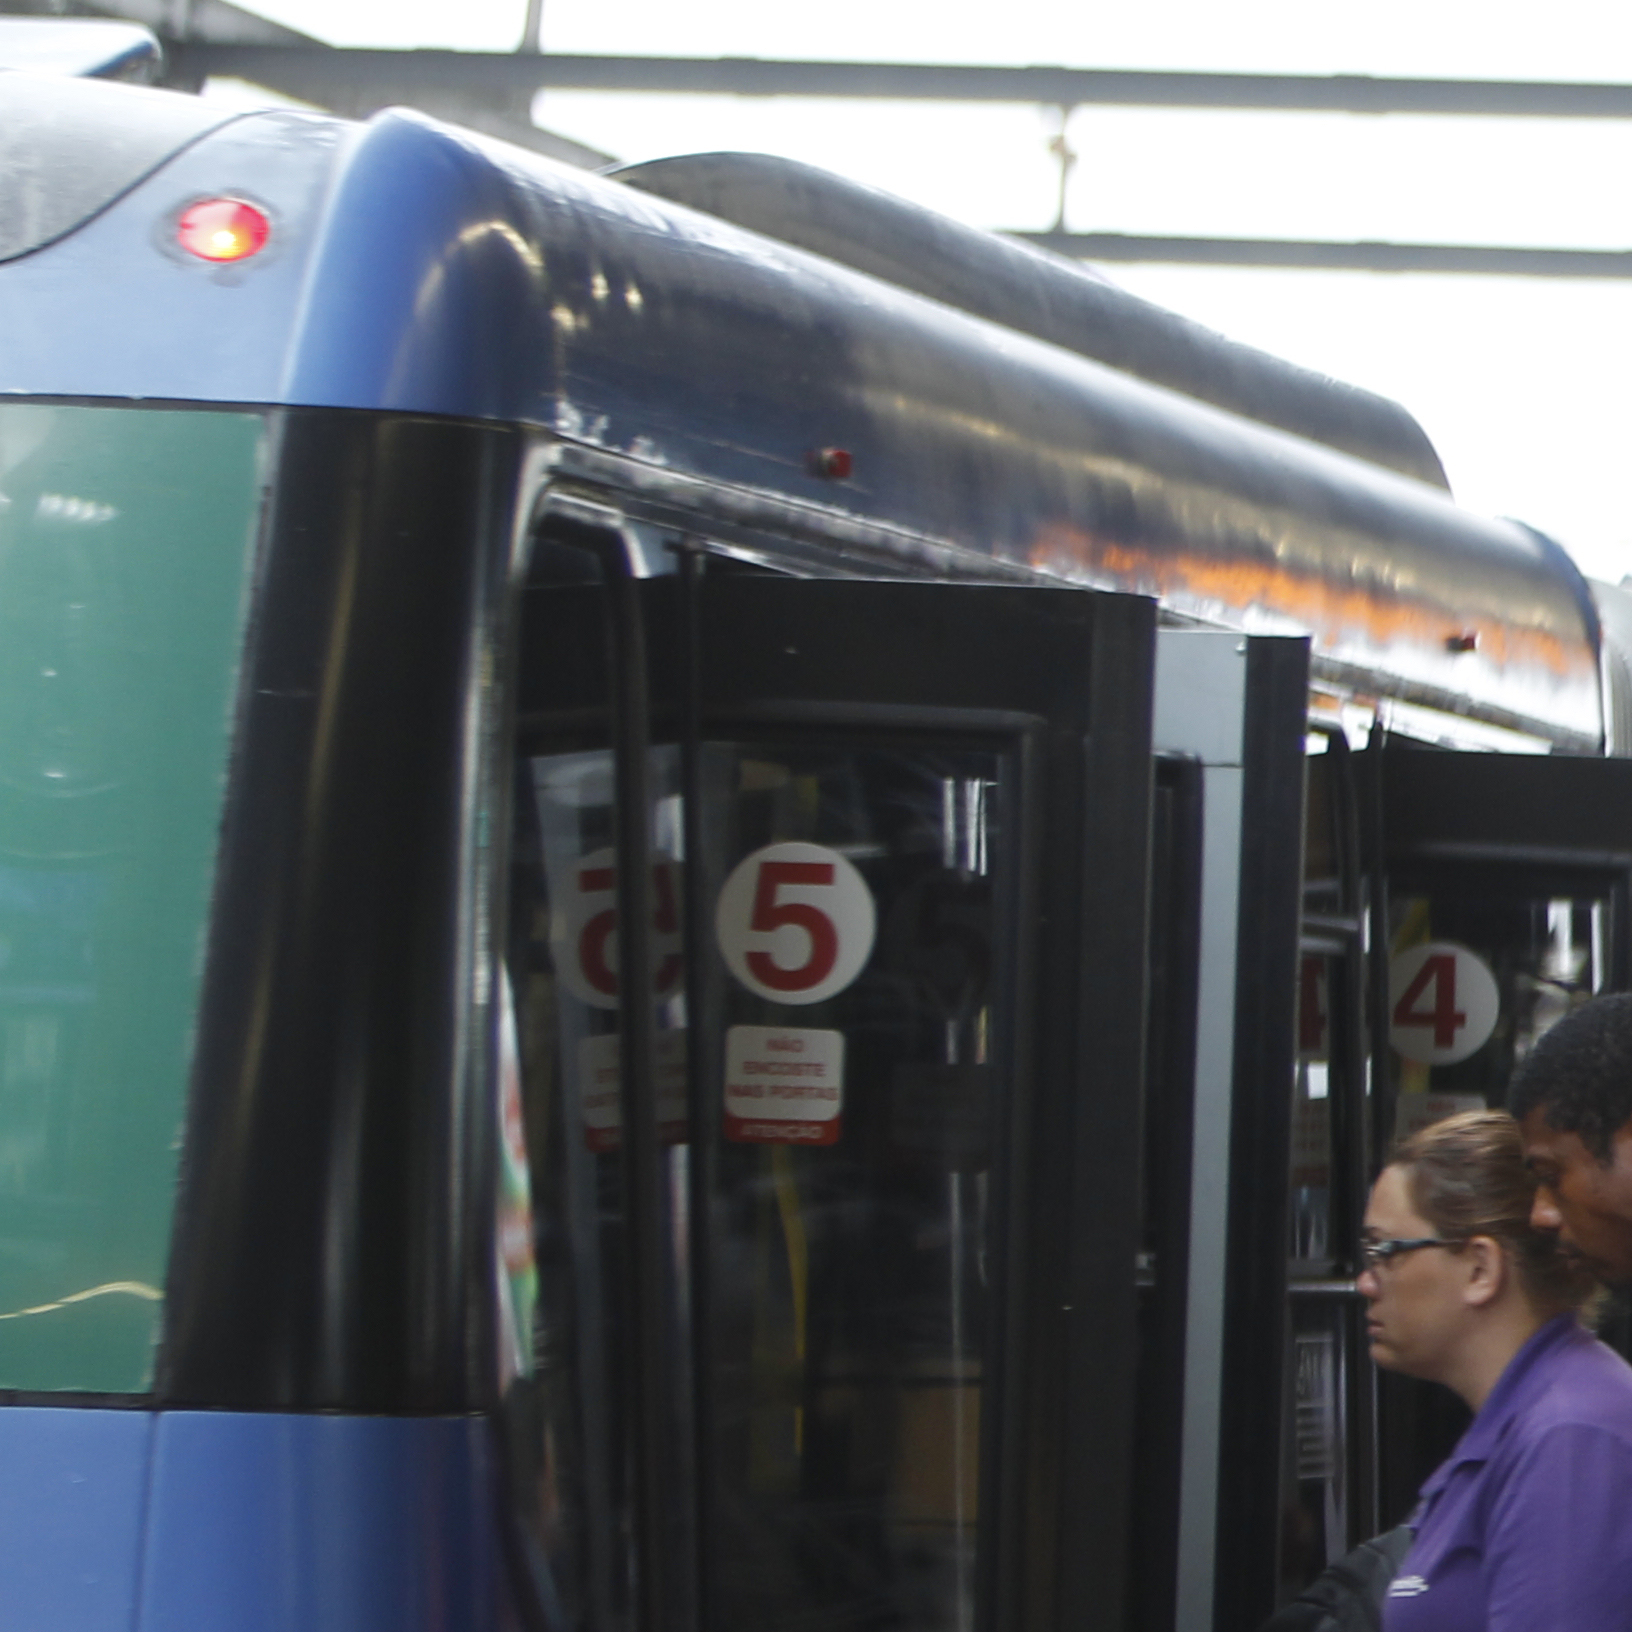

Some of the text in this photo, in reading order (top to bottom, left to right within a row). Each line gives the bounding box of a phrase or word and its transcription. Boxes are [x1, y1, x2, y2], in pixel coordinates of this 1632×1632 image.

[745, 861, 839, 992] 5
[1393, 954, 1466, 1049] 4
[742, 1060, 827, 1078] ENCOSTE
[725, 1084, 839, 1101] NAS PORTAS
[740, 1123, 825, 1142] ATENÇÃO
